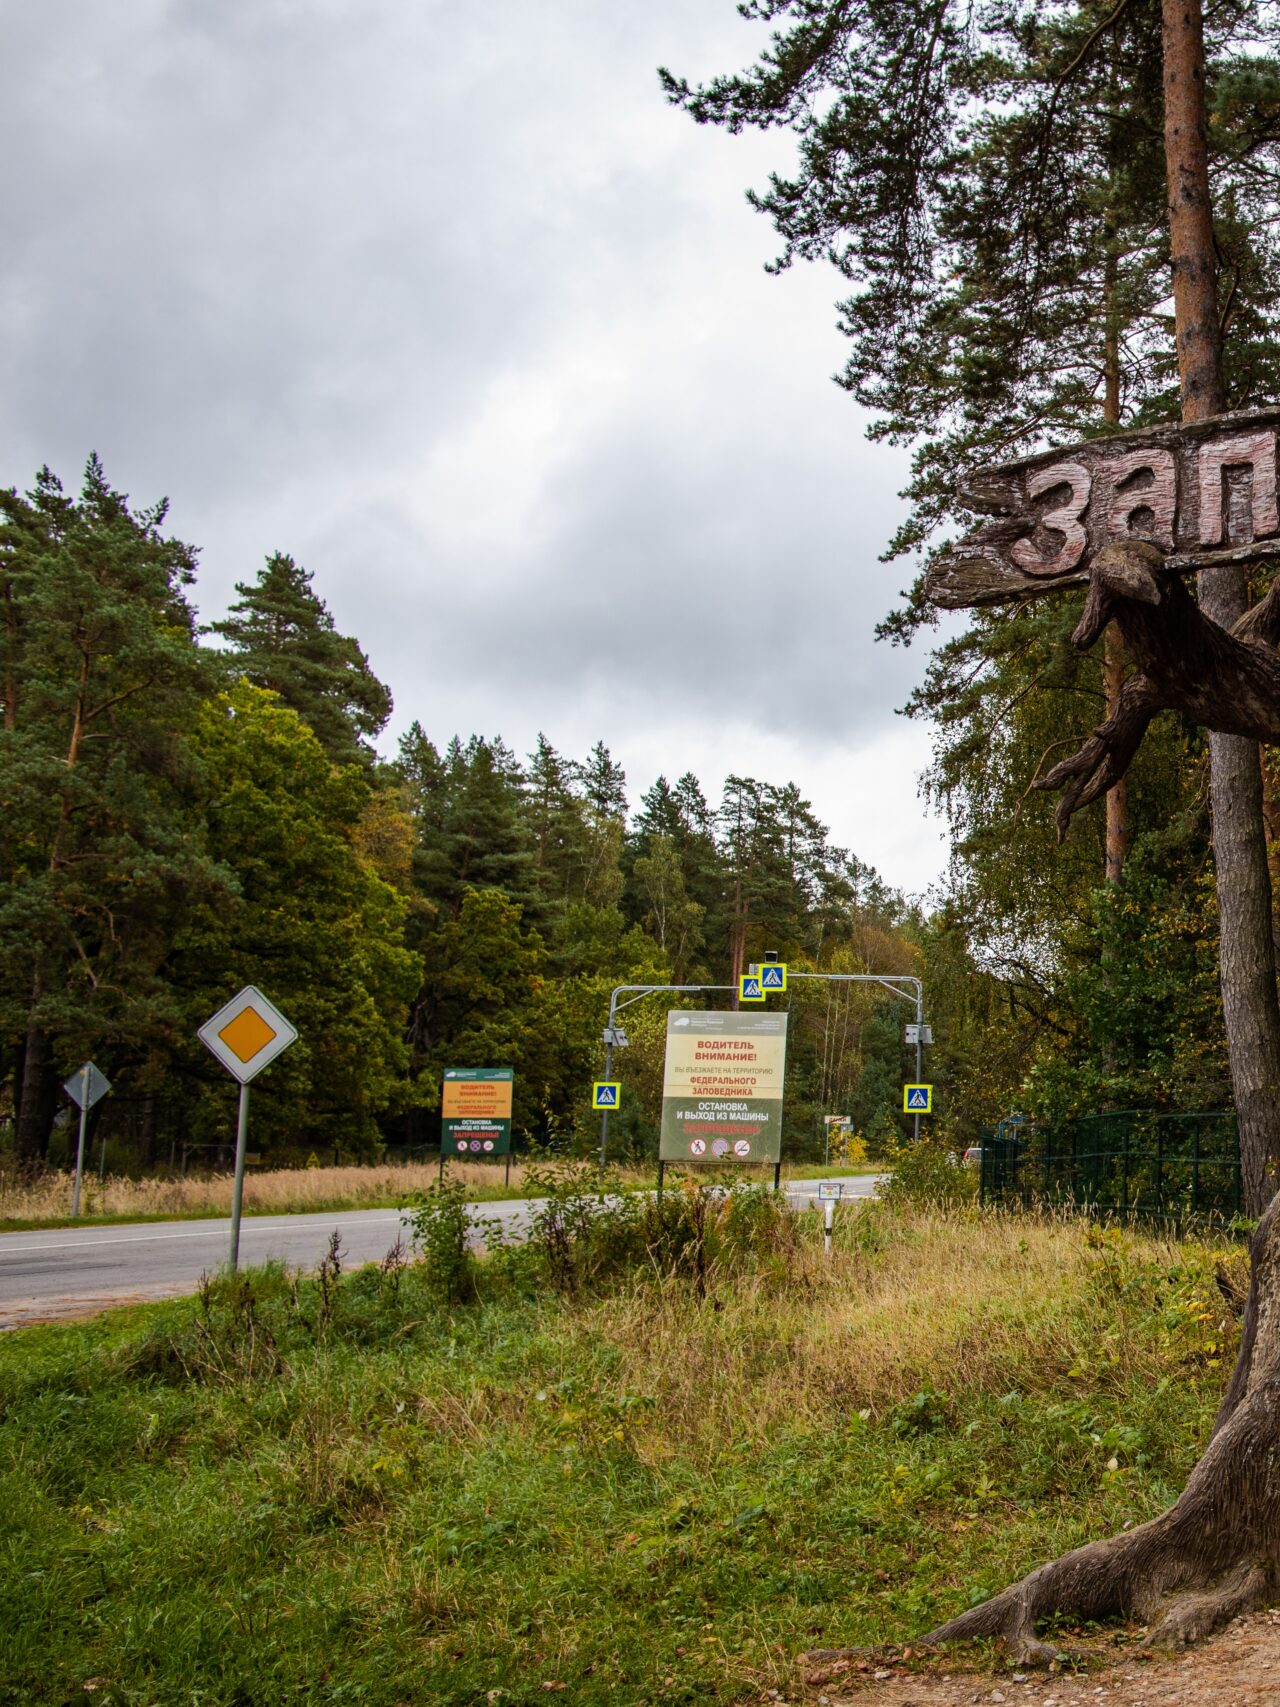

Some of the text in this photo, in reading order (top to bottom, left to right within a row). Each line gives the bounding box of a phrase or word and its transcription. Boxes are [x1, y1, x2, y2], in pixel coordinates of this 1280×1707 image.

[697, 1041, 754, 1050] ВОДИТЕЛЬ
[695, 1052, 757, 1061] ВНИМАНИЕ!
[686, 1066, 721, 1074] ВЪЕЗЖАЕТЕ
[733, 1067, 773, 1075] ТЕРРИТОРИЮ
[690, 1076, 757, 1085] ФЕДЕРАЛЬНОГО
[692, 1088, 753, 1096] ЗАПОВЕДНИКА
[698, 1102, 748, 1111] ОСТАНОВКА
[676, 1111, 769, 1121] И ВЫХОД ИЗ МАШИНЫ
